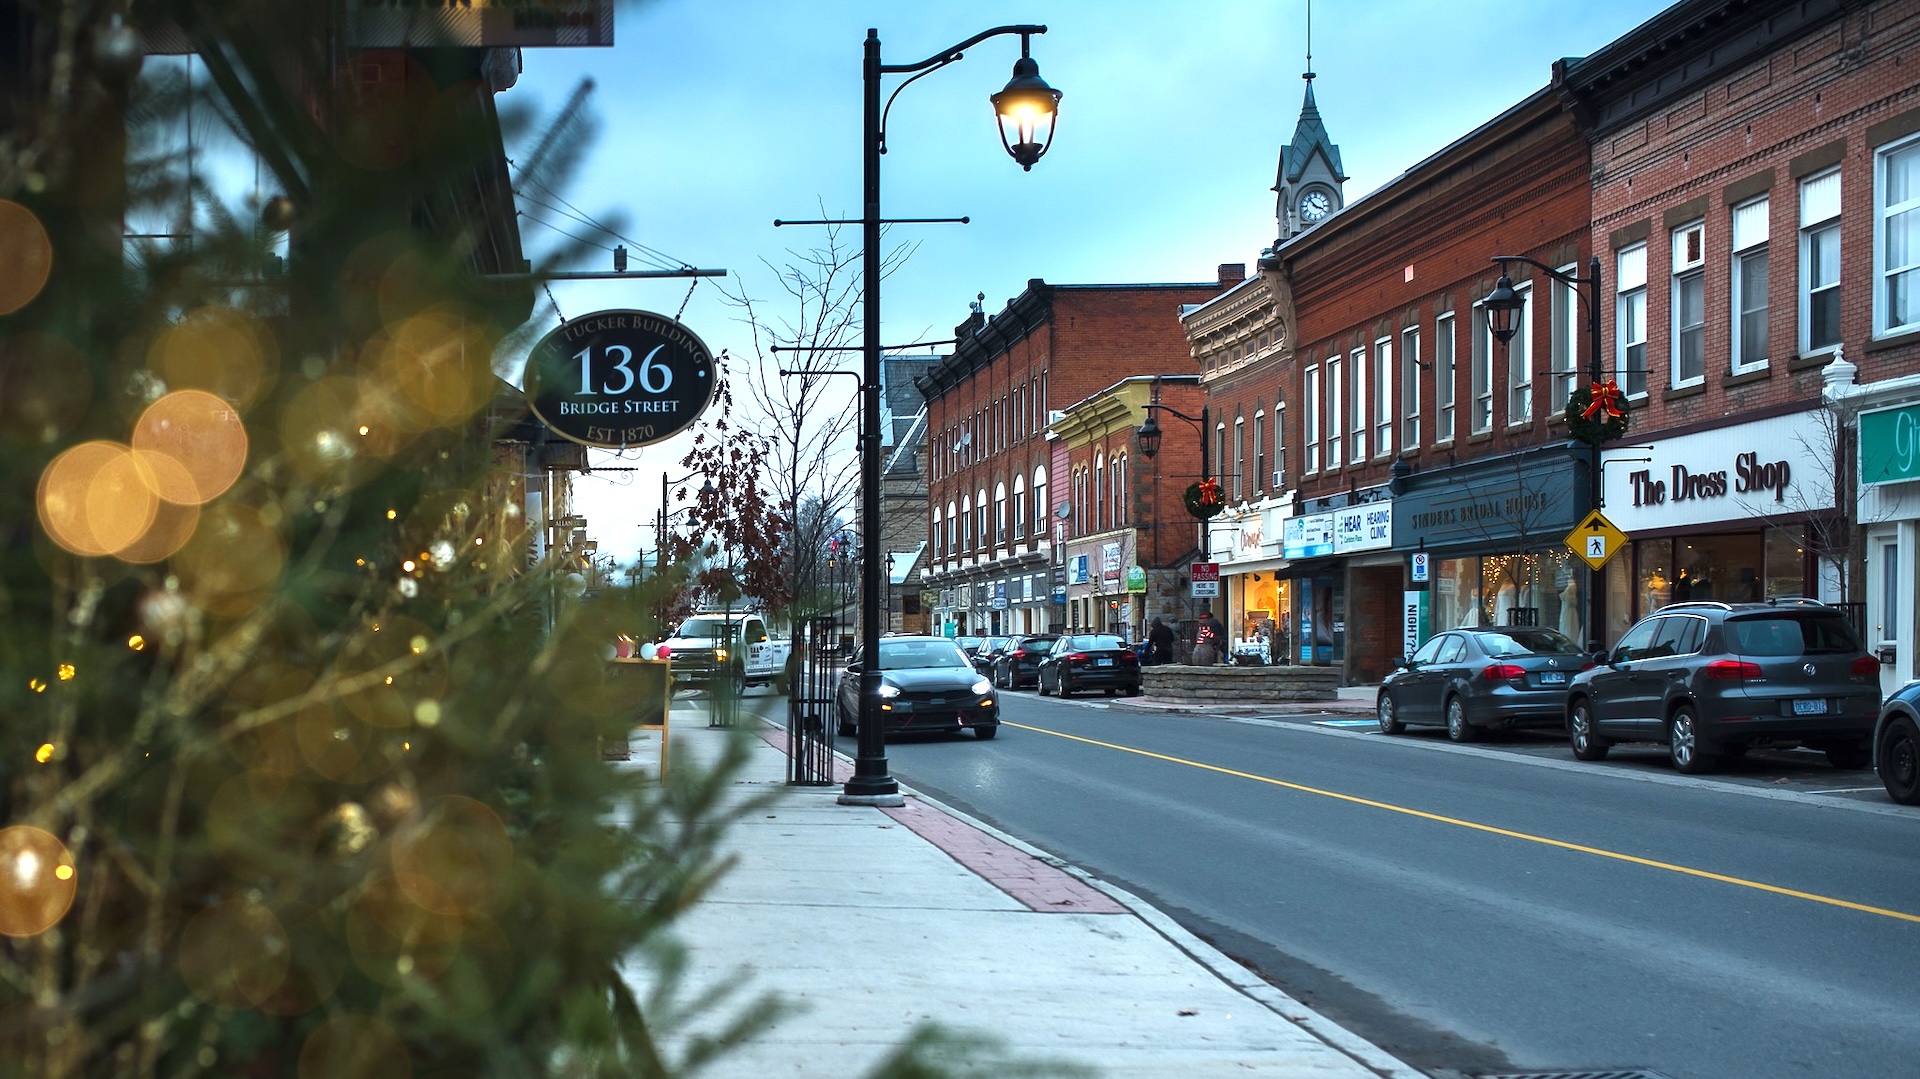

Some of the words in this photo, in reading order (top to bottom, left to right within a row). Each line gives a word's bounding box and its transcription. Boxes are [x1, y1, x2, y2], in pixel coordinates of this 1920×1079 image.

[562, 316, 627, 343] TUCKER
[632, 315, 706, 366] BUILDING
[571, 343, 674, 395] 136
[560, 401, 619, 415] BRIDGE
[624, 399, 680, 414] STREET
[586, 425, 615, 441] EST
[619, 424, 655, 442] 1870
[1630, 468, 1666, 508] The
[1671, 463, 1728, 502] Dress
[1735, 450, 1792, 503] Shop
[1366, 509, 1390, 526] HEARING
[1412, 508, 1456, 530] SINDERS
[1459, 501, 1500, 523] BRIDAL
[1504, 492, 1546, 515] HOUSE
[1344, 514, 1362, 533] HEAR
[1370, 525, 1387, 540] CLINIC
[1192, 572, 1218, 581] PASSING
[1200, 564, 1210, 573] NO
[1407, 604, 1417, 640] NIGHT
